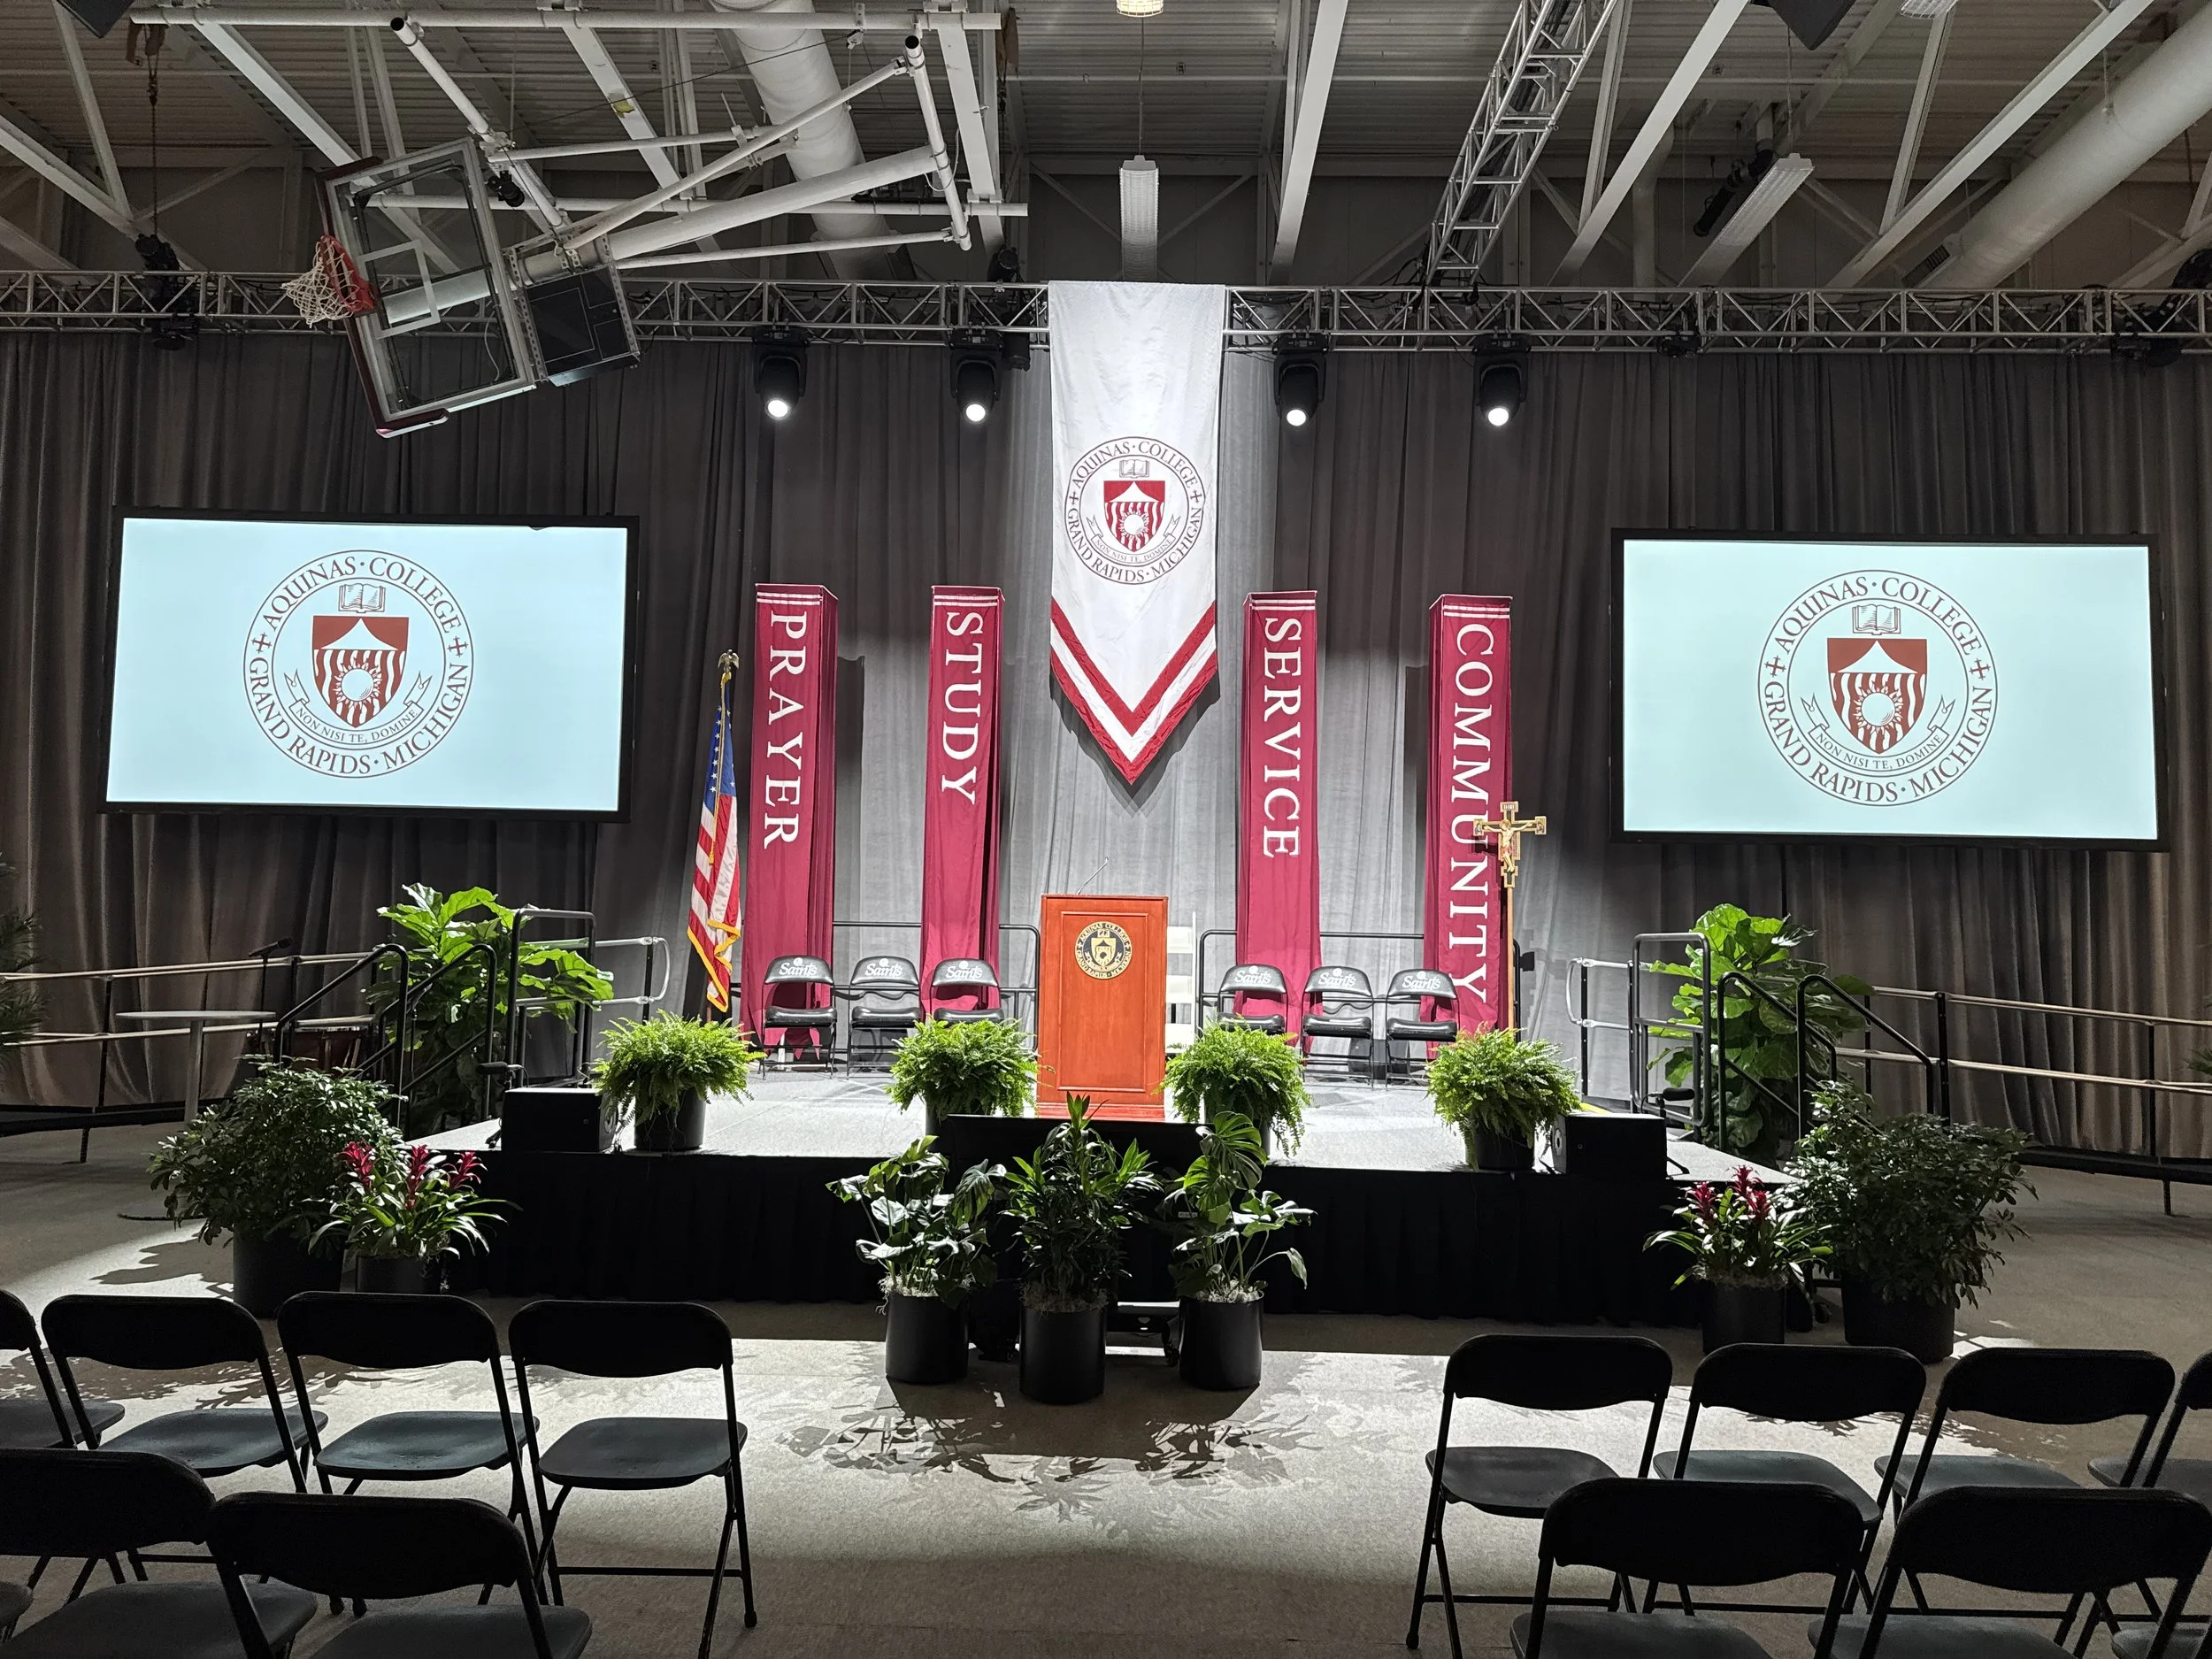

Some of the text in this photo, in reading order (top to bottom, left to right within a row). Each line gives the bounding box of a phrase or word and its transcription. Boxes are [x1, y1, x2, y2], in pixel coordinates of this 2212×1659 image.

[1072, 442, 1198, 489] AQUINAS COLLEGE
[1067, 507, 1202, 582] GRAND RAPIDS MICHIGAN
[1096, 539, 1110, 555] NON
[1111, 551, 1127, 562] NISI
[263, 556, 462, 634] AQUINAS COLLEGE
[1774, 576, 1982, 656] AQUINAS COLLEGE
[249, 657, 469, 774] GRAND RAPIDS MICHIGAN
[296, 708, 418, 744] NON NISI TE, DOMINE
[764, 610, 807, 849] PRAYER
[941, 611, 984, 805] STUDY
[1263, 617, 1302, 859] SERVICE
[1764, 680, 1993, 803] GRAND RAPIDS MICHIGAN
[1816, 733, 1944, 771] NON NISI TE, DOMINE
[1448, 623, 1495, 1002] COMMUNITY
[779, 963, 818, 976] Saints
[864, 963, 903, 977] Saints
[945, 964, 983, 980] Saints
[1234, 969, 1271, 985] Saints
[1317, 972, 1356, 987] Saints
[1402, 975, 1441, 991] Saints
